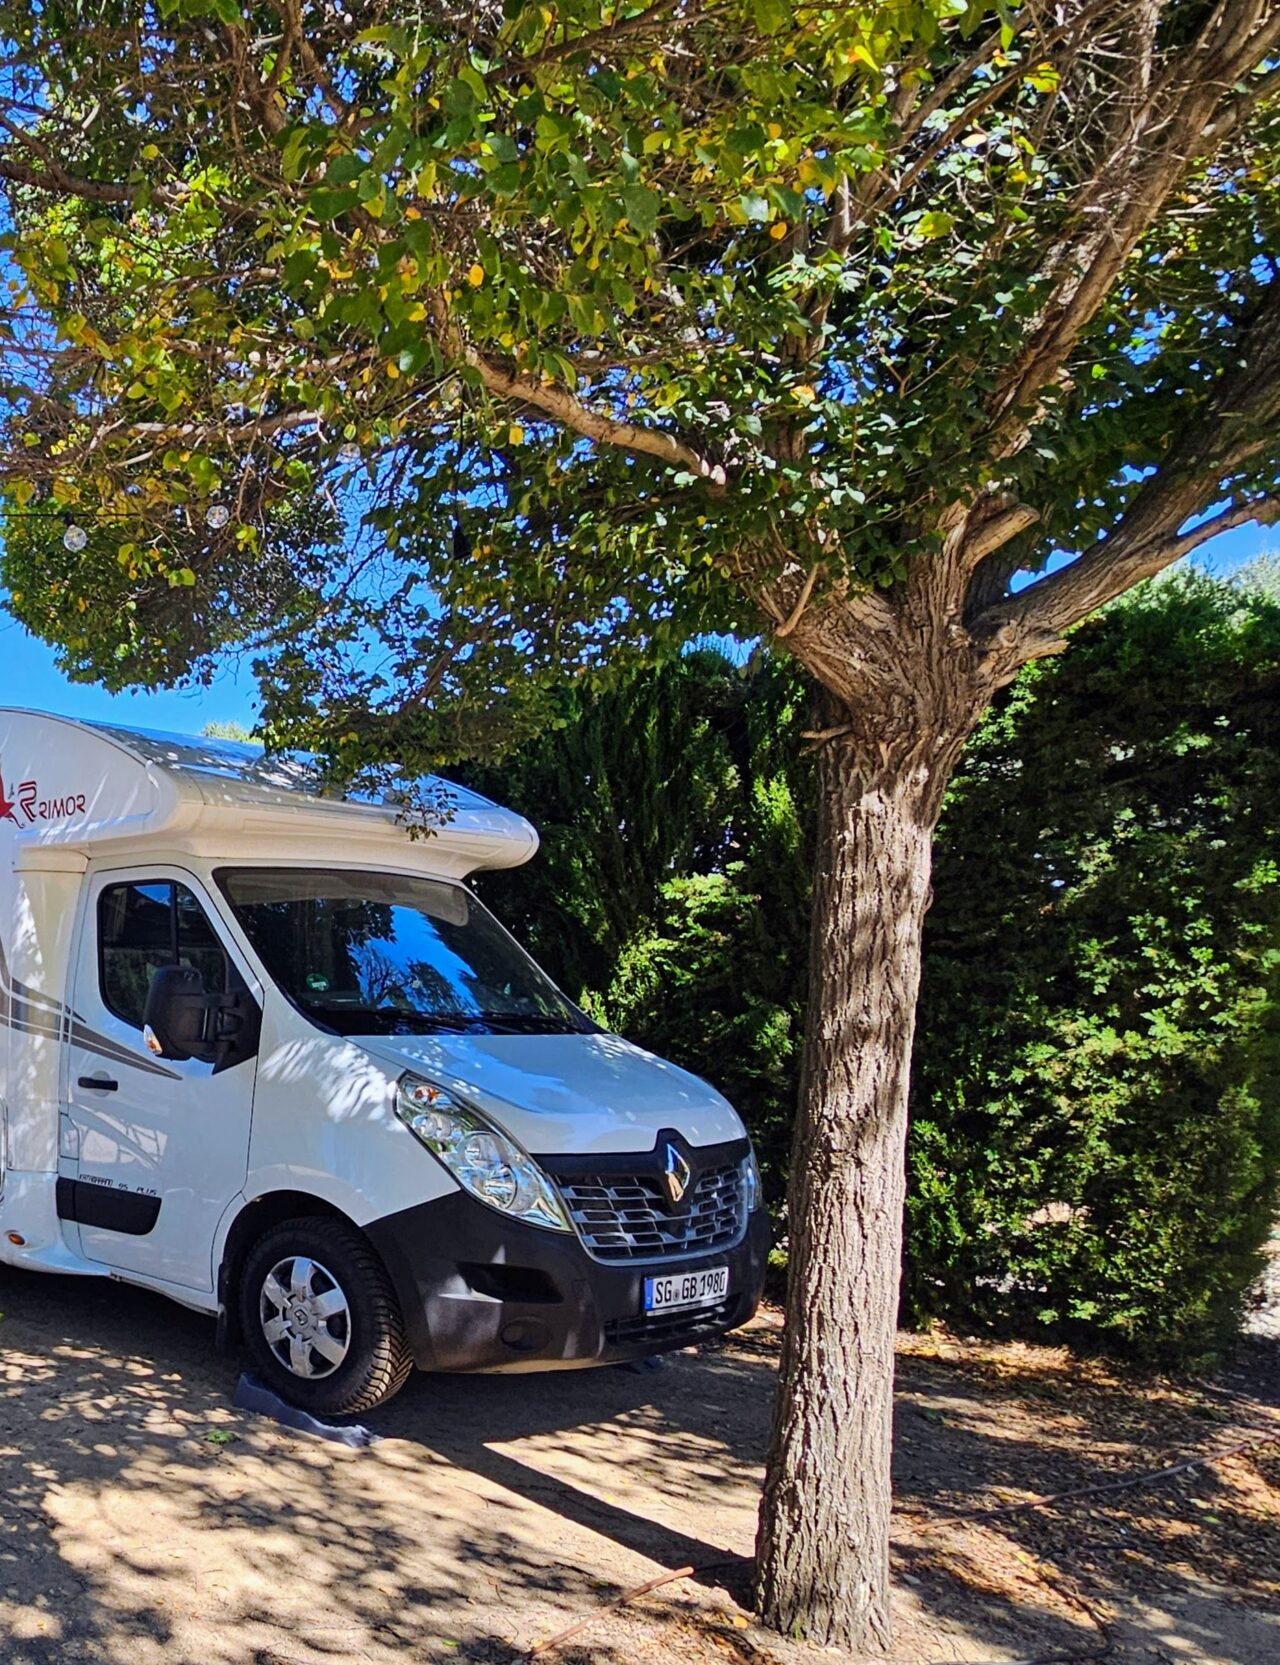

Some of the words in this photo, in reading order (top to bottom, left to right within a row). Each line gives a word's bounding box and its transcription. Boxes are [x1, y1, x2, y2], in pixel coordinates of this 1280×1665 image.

[655, 1280, 672, 1304] SG
[681, 1277, 697, 1300] GB
[699, 1271, 725, 1296] 1980
